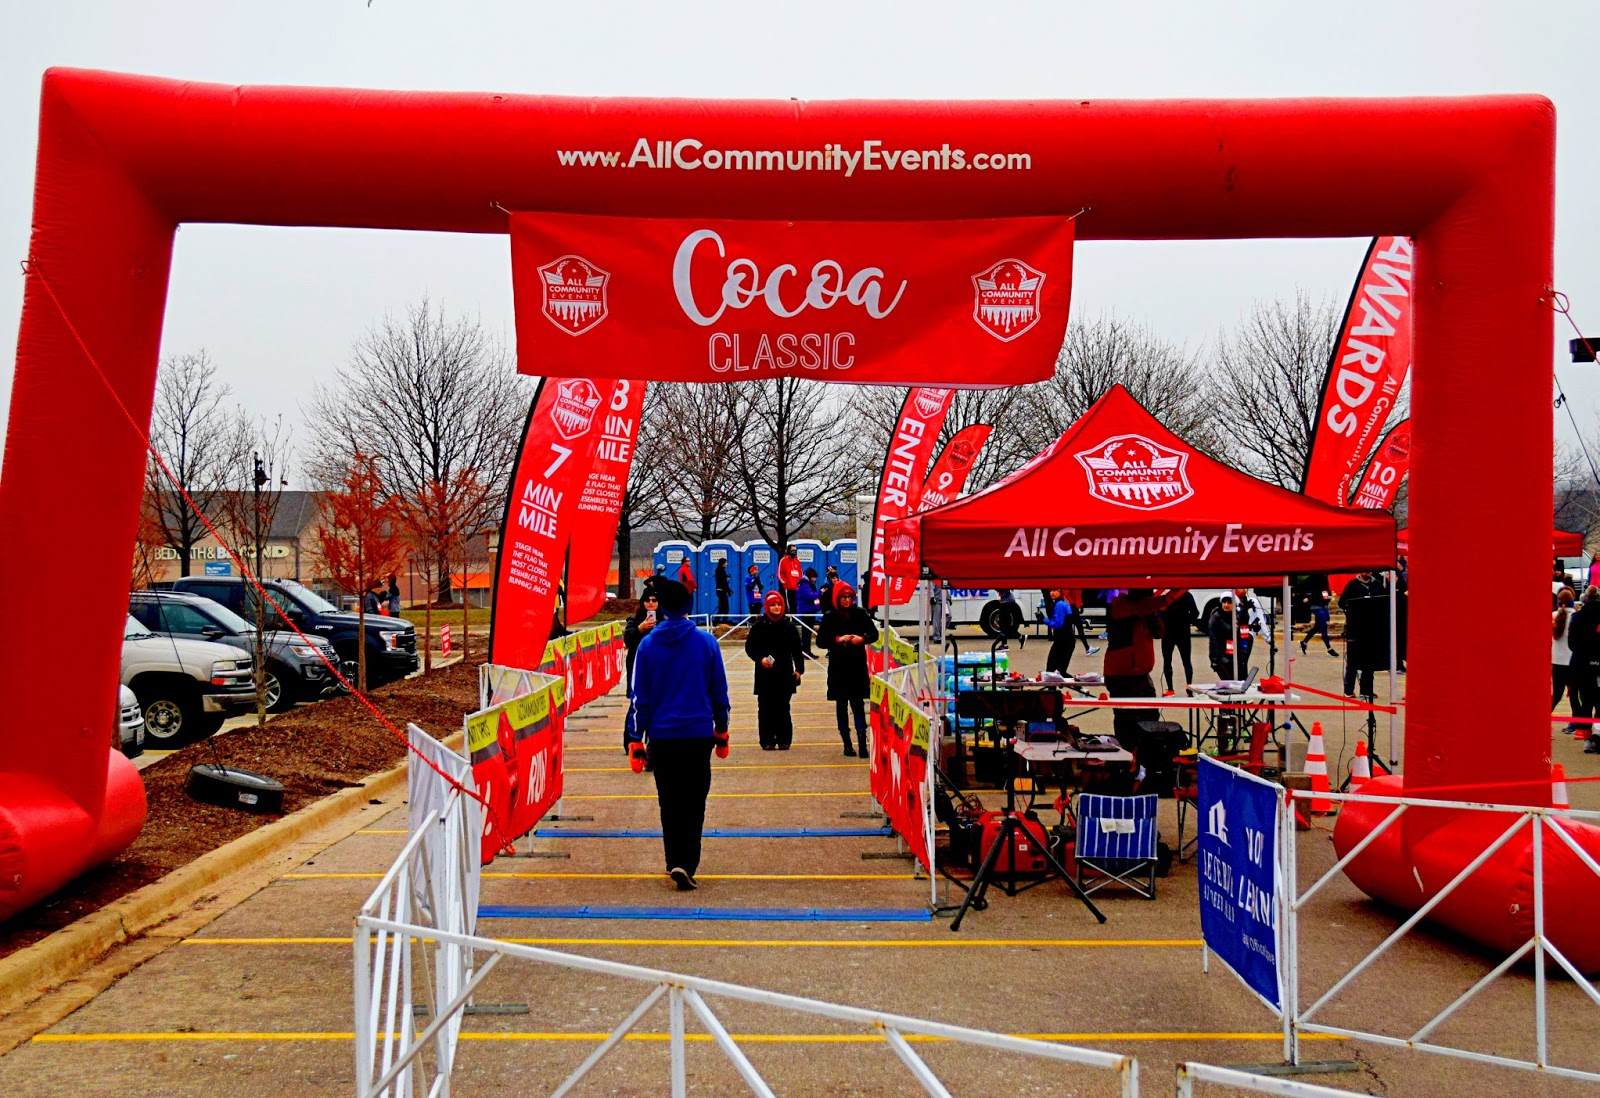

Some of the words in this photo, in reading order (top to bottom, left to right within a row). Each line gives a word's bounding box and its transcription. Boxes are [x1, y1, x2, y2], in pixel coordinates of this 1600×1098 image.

[556, 138, 1032, 177] www.AllCommunityEvents.com
[567, 278, 583, 286] ALL
[672, 229, 907, 327] Cocoa
[1000, 282, 1016, 291] ALL
[549, 285, 600, 295] COMMUNITY
[981, 291, 1033, 299] COMMUNITY
[1326, 236, 1411, 438] AWARDS
[708, 332, 855, 373] CLASSIC
[1381, 374, 1398, 396] All
[560, 397, 592, 413] COMMUNITY
[573, 395, 584, 404] ALL
[550, 442, 574, 480] 7
[882, 417, 926, 508] ENTER
[1122, 460, 1148, 469] ALL
[938, 472, 954, 491] 9
[1096, 468, 1176, 477] COMMUNITY
[1102, 475, 1174, 483] EVENTS
[1369, 461, 1397, 486] 10
[523, 479, 564, 513] MIN
[924, 488, 949, 505] MIN
[1362, 481, 1389, 500] MIN
[518, 505, 557, 539] MILE
[1004, 527, 1048, 559] All
[1053, 526, 1219, 561] Community
[1222, 523, 1314, 554] Events
